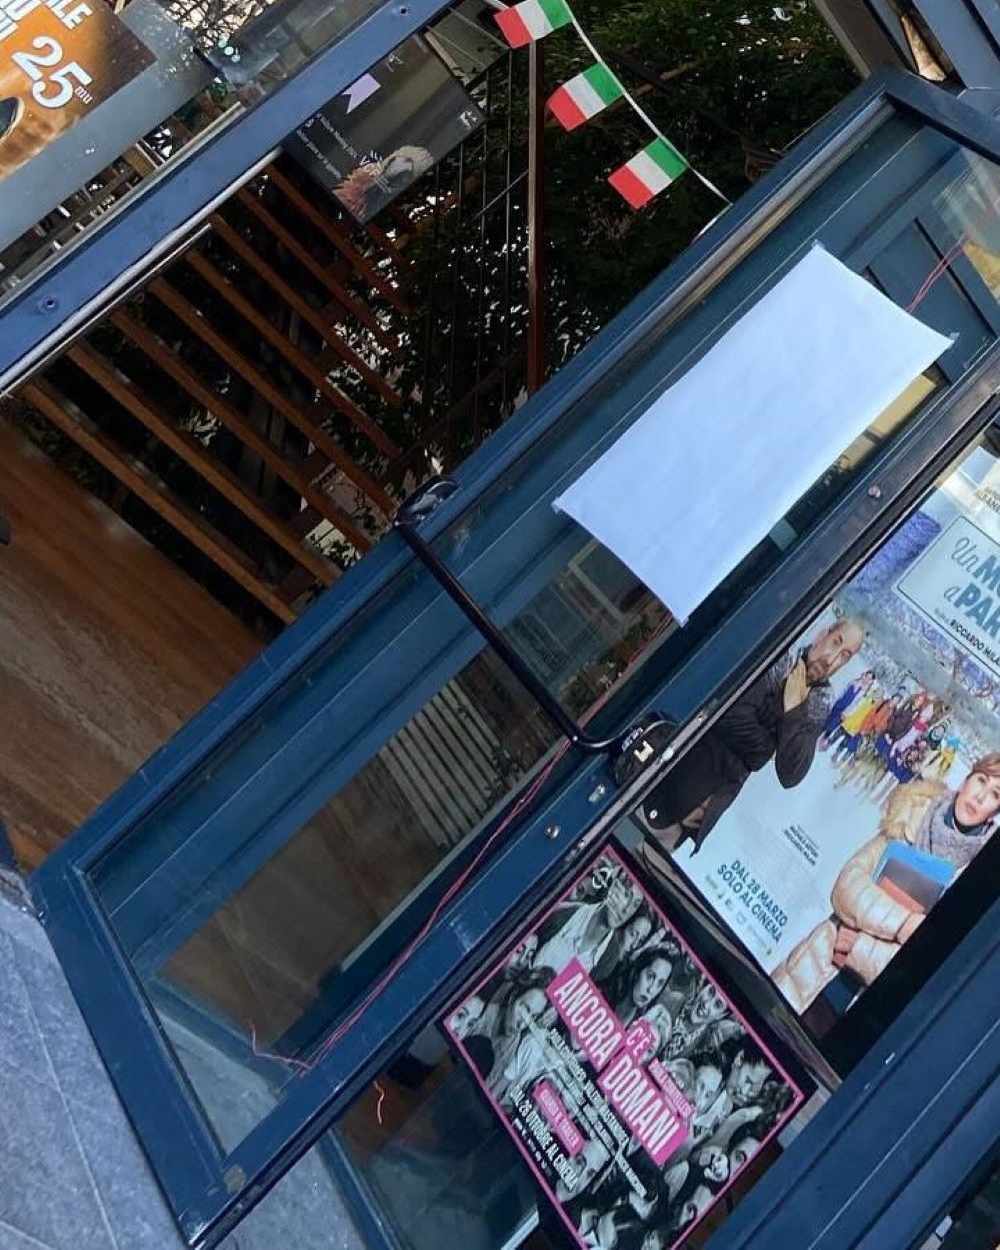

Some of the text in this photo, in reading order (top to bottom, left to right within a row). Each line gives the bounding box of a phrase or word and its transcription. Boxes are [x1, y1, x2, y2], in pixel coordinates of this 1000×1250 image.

[11, 36, 94, 108] 25
[951, 537, 978, 577] Un
[717, 864, 783, 944] SOLO AL CINEMA
[731, 860, 788, 928] DAL 28 MARZO
[554, 972, 623, 1067] ANCORA
[510, 1084, 526, 1107] DAL
[525, 1110, 554, 1151] OTTOBRE
[553, 1153, 579, 1191] CINEMA
[602, 1053, 681, 1156] DOMANI
